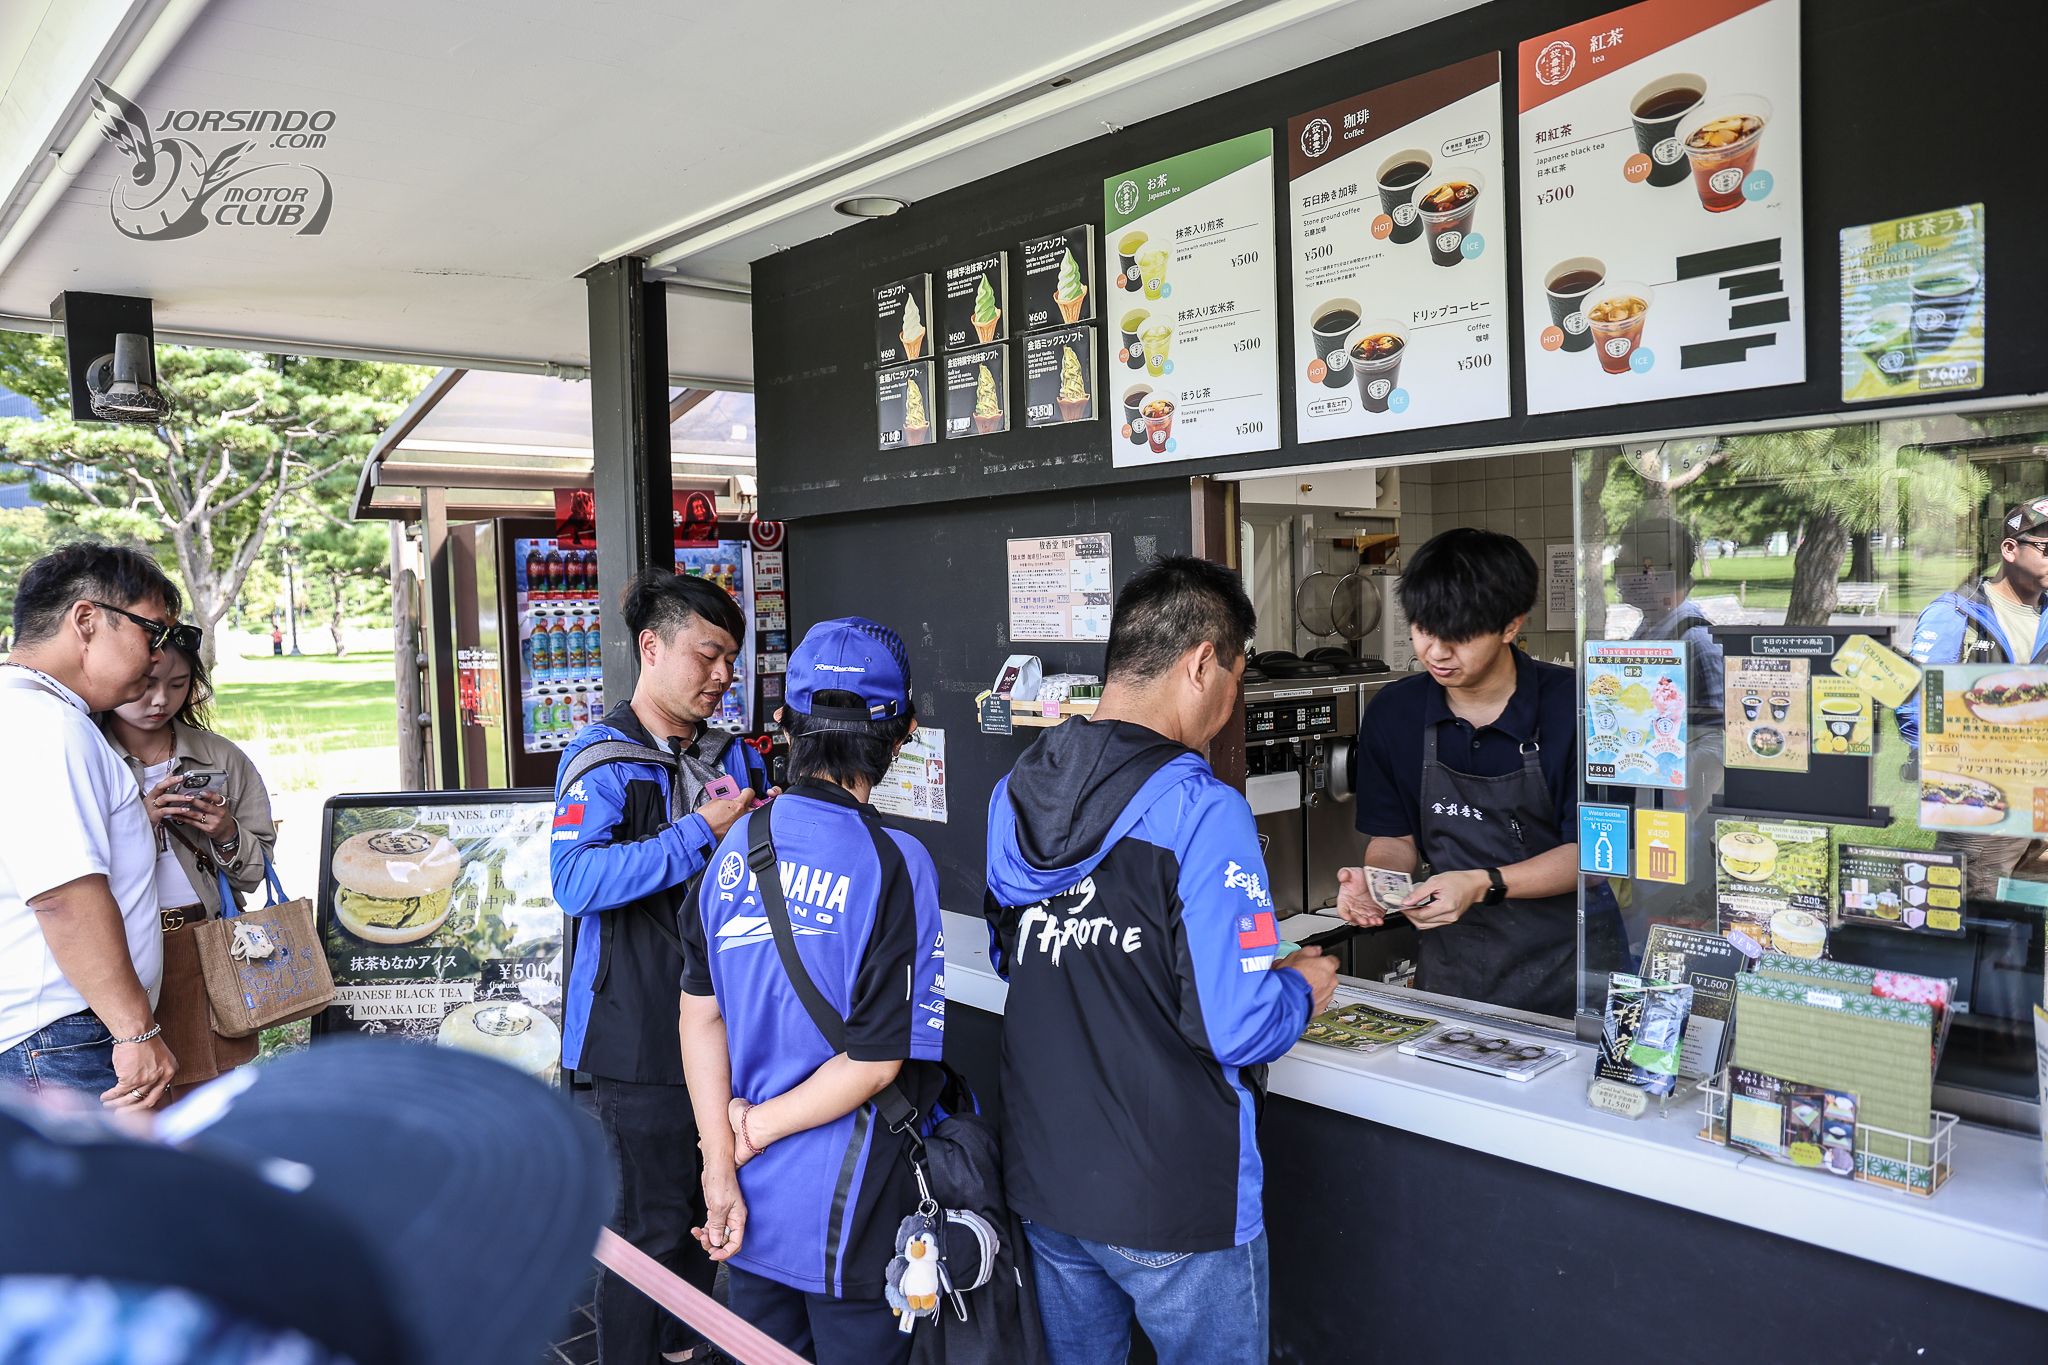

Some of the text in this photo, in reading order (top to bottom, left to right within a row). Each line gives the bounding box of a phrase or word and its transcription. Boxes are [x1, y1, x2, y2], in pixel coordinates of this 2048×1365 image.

[1589, 27, 1624, 53] 紅茶
[1592, 53, 1605, 64] tea
[1344, 108, 1369, 129] 珈琲
[1344, 128, 1365, 140] Coffee
[1535, 124, 1572, 144] 和紅茶
[1536, 142, 1605, 166] Japanese black tea
[1537, 164, 1567, 177] 日本紅茶
[1627, 163, 1648, 175] HOT
[1147, 173, 1168, 191] お茶
[1749, 180, 1766, 191] ICE
[1148, 189, 1171, 202] Japanese
[1537, 184, 1575, 206] ¥500
[1303, 206, 1361, 227] Stone ground coffee
[1175, 218, 1224, 239] 抹茶入り煎茶
[1374, 222, 1390, 233] HOT
[1025, 236, 1067, 255] ミックスソフト
[1466, 241, 1479, 250] ICE
[1231, 251, 1259, 267] ¥500
[1304, 243, 1333, 262] ¥500
[1849, 251, 1899, 269] Matcha
[878, 284, 906, 300] バニラソフト
[1029, 311, 1047, 322] ¥600
[1178, 301, 1235, 322] 抹茶入り玄米茶
[1412, 301, 1490, 323] ドリップコーヒー
[1467, 322, 1490, 332] Coffee
[949, 331, 966, 342] ¥600
[1027, 332, 1083, 351] 金箔ミックスソフト
[1543, 334, 1561, 344] HOT
[1233, 337, 1261, 352] ¥500
[881, 348, 895, 358] ¥600
[1457, 353, 1492, 371] ¥500
[1635, 356, 1648, 365] ICE
[879, 368, 919, 384] 金箔バニラソフト
[1309, 367, 1325, 376] HOT
[1927, 365, 1969, 380] ¥600
[1181, 388, 1211, 401] ほうじ茶
[1393, 397, 1404, 405] ICE
[1236, 421, 1263, 435] ¥500
[1928, 744, 1958, 753] ¥450
[1590, 765, 1614, 773] ¥800
[427, 809, 486, 822] JAPANESE
[1590, 822, 1613, 831] ¥150
[1653, 819, 1668, 827] Beer
[1646, 829, 1670, 838] ¥450
[1730, 883, 1779, 895] 抹茶もなかアイス
[1797, 895, 1820, 905] ¥500
[1687, 935, 1702, 943] leaf
[1706, 939, 1731, 948] Matcha
[1729, 932, 1760, 956] NEW!
[350, 954, 458, 971] 抹茶もなかアイス
[499, 962, 549, 979] ¥500
[1616, 976, 1639, 986] SAMPLE
[395, 988, 435, 1000] BLACK
[439, 987, 463, 998] TEA
[1810, 994, 1839, 1005] SAMPLE
[360, 1003, 437, 1015] MONAKA ICE
